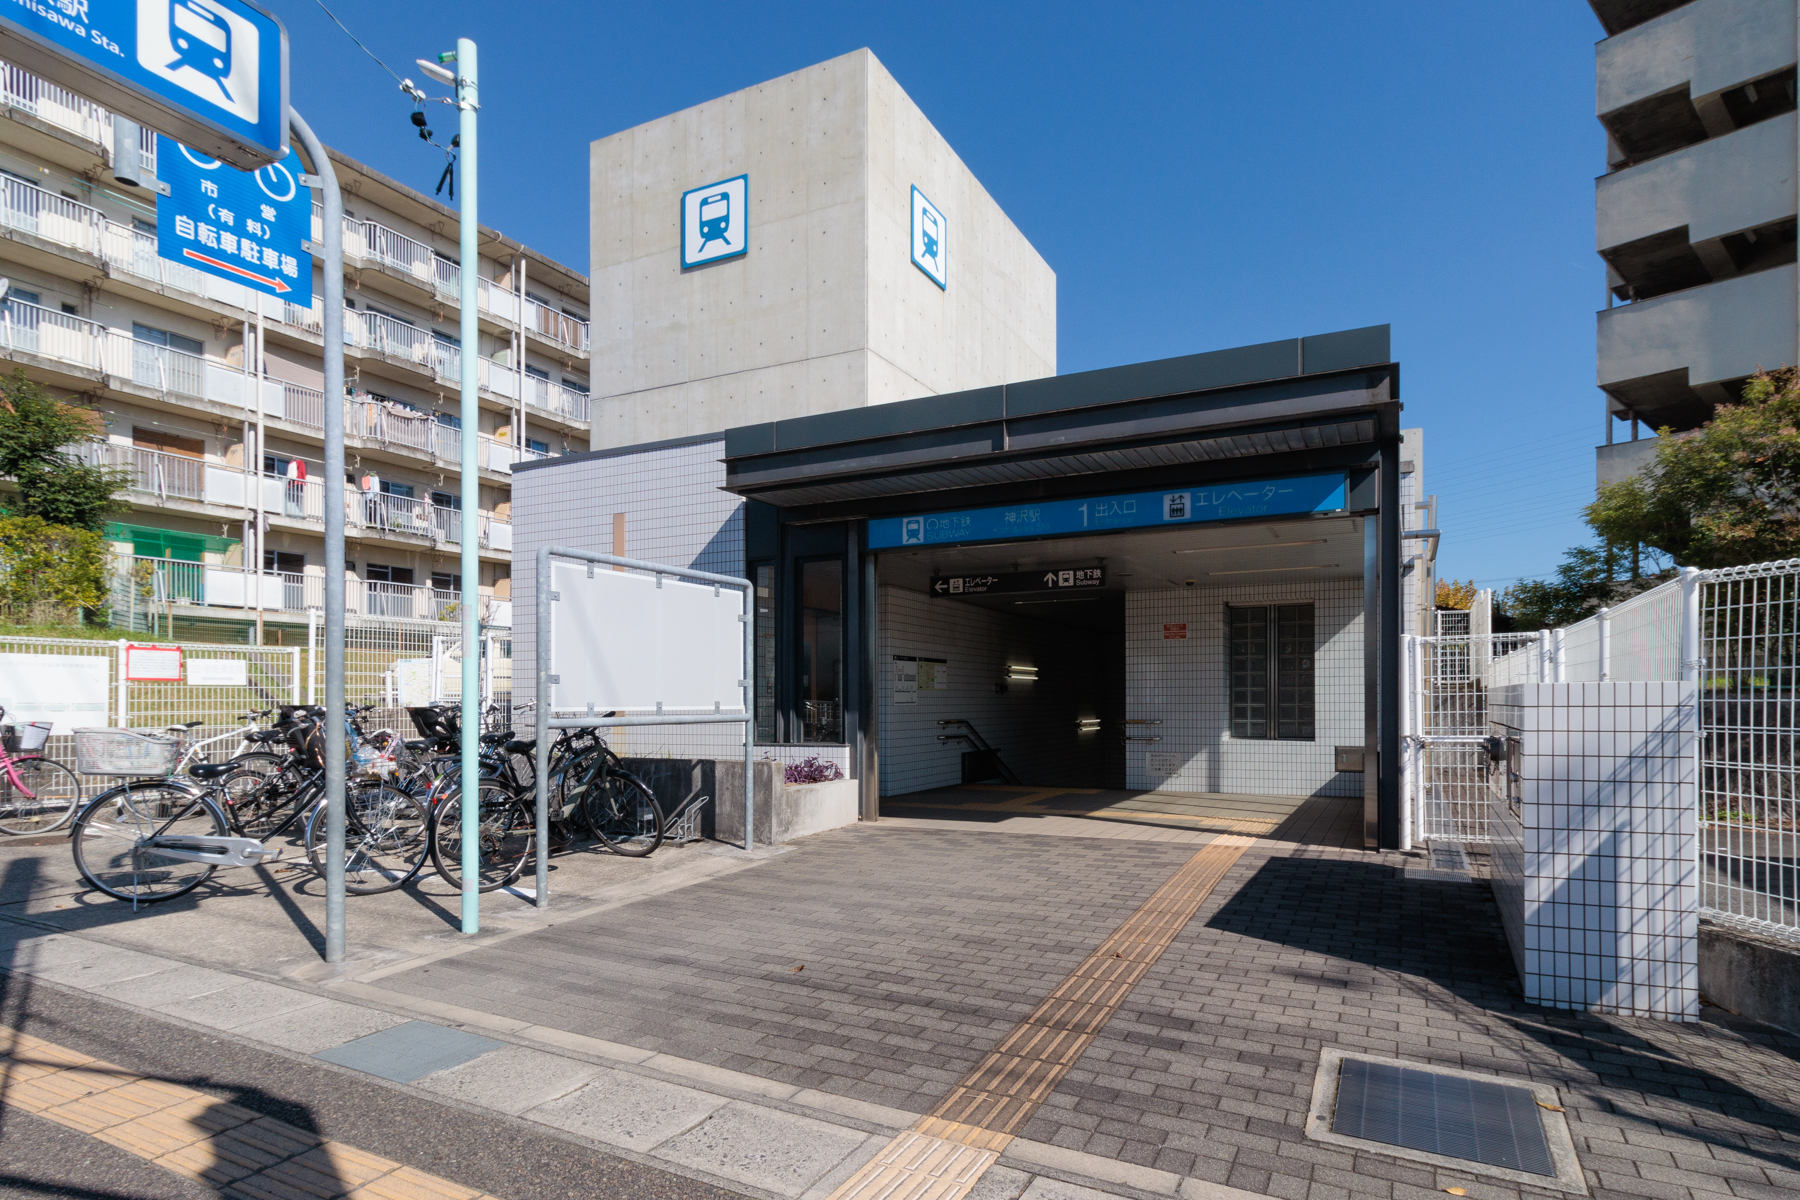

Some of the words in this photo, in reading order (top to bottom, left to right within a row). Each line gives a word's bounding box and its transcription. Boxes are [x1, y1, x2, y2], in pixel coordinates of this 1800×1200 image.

[90, 29, 125, 58] Sta.
[175, 215, 298, 279] 自転車駐車場
[1195, 485, 1294, 506] エレベーター
[1004, 508, 1041, 524] 神沢駅
[1078, 502, 1088, 527] 1
[1095, 499, 1137, 517] 出入口
[1218, 503, 1268, 517] Elevator
[1095, 516, 1133, 526] Entrance
[926, 527, 971, 540] SUBWAY
[992, 522, 1034, 535] Kamisawa
[1075, 568, 1102, 580] 地下鉄
[964, 575, 999, 587] エレベーター
[1075, 578, 1100, 586] Subway
[964, 585, 988, 593] Elevator
